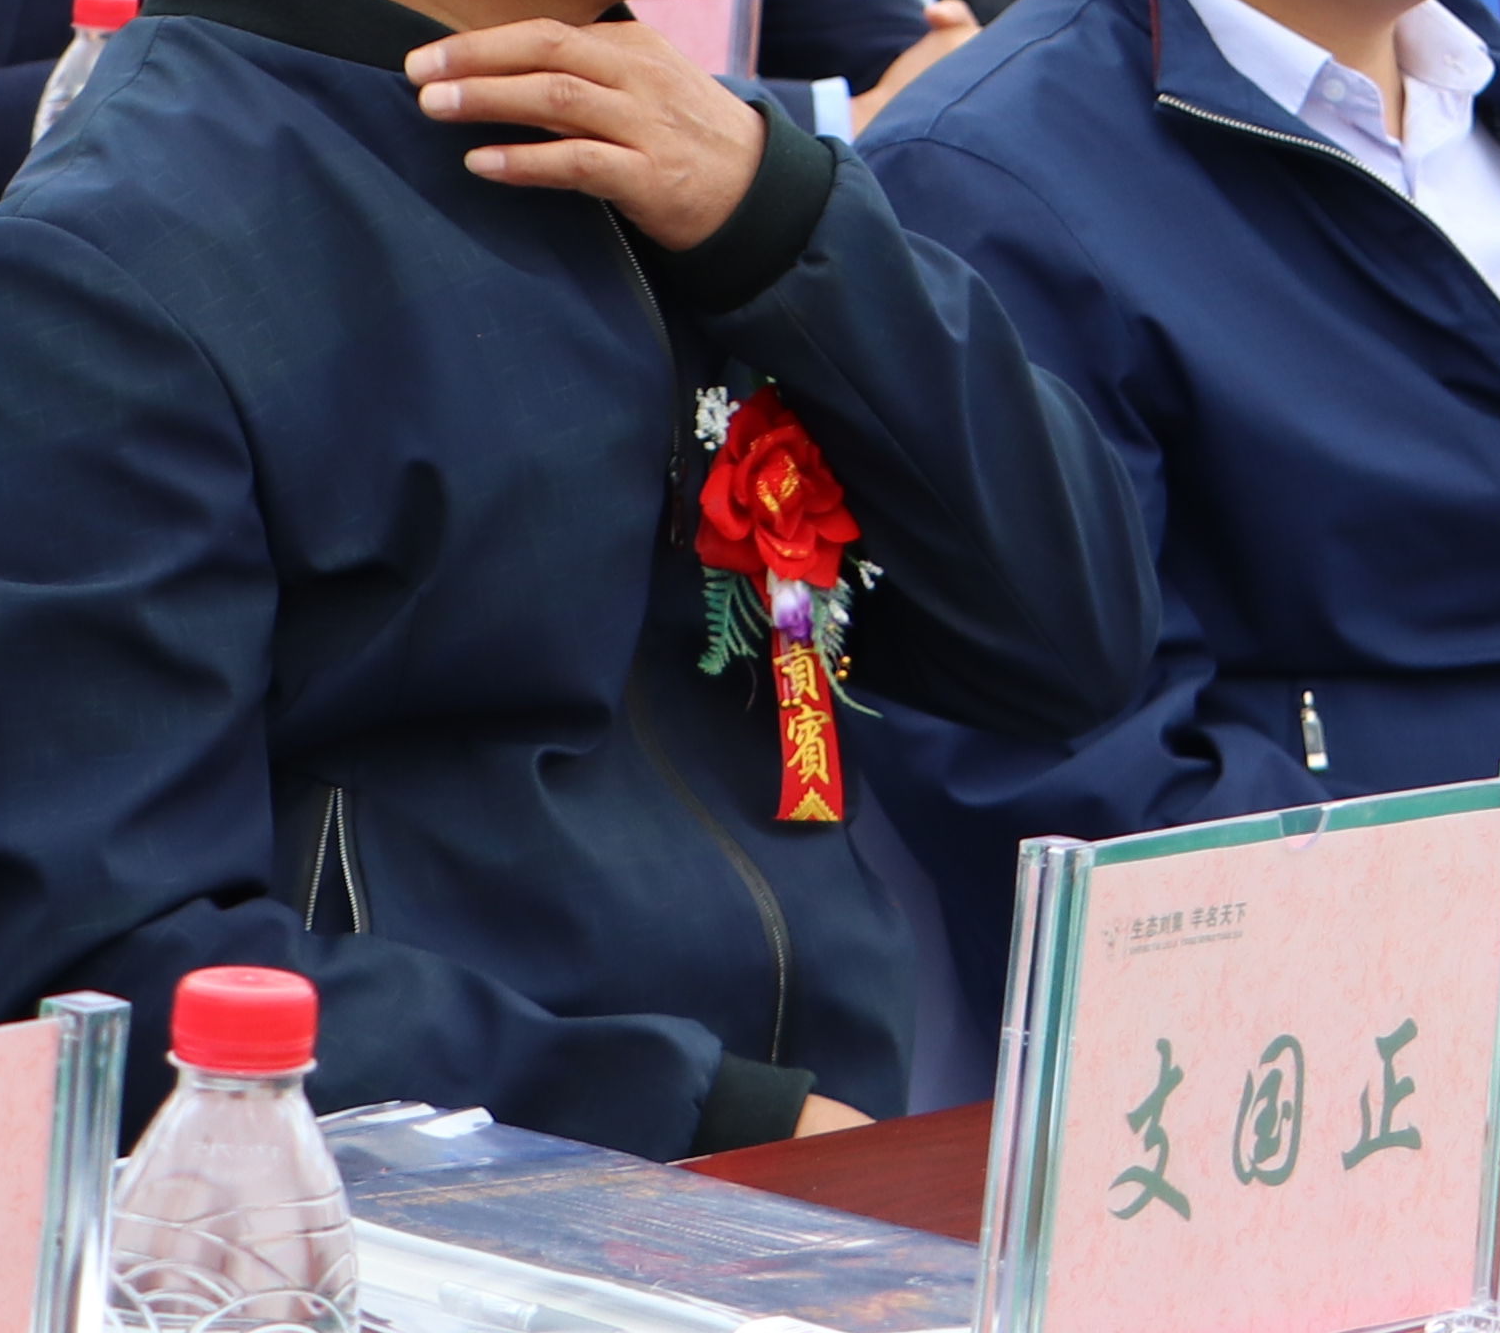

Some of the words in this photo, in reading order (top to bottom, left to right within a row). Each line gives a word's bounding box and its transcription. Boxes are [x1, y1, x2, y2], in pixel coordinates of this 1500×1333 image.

[1130, 910, 1183, 939] 生态刘集
[1191, 902, 1247, 929] 羊名天下
